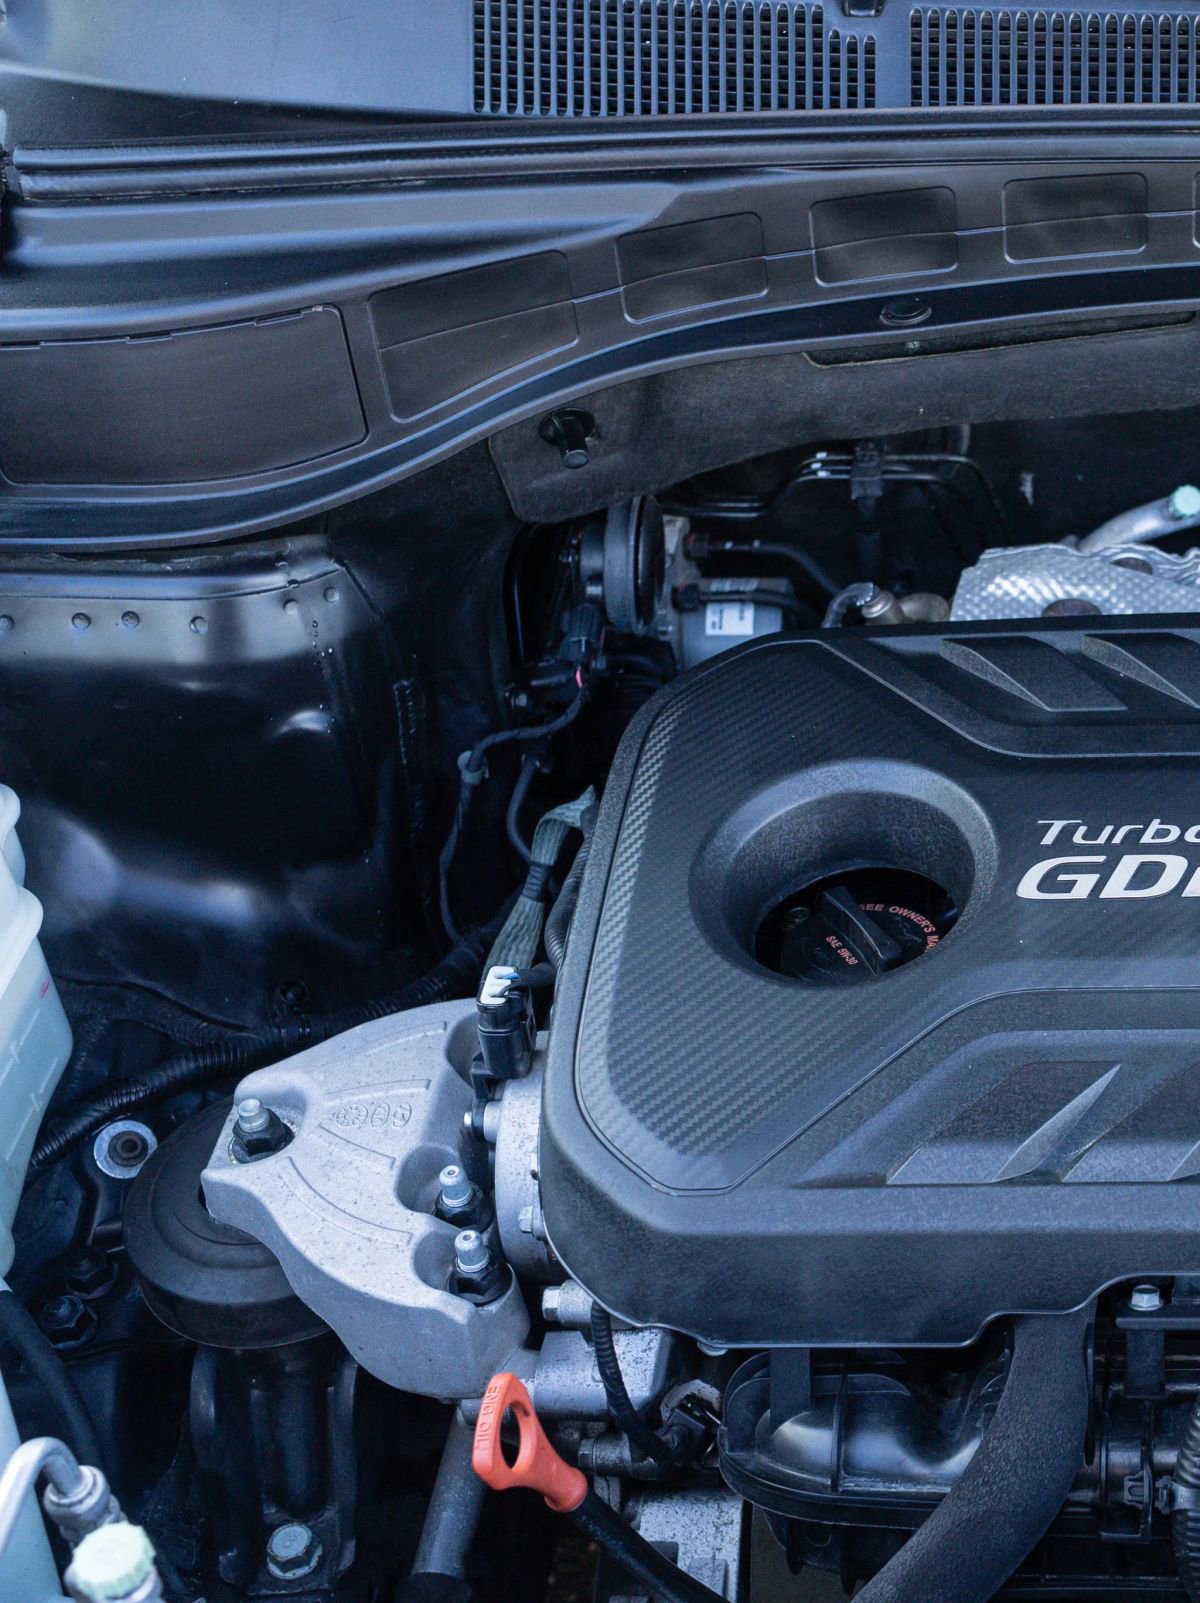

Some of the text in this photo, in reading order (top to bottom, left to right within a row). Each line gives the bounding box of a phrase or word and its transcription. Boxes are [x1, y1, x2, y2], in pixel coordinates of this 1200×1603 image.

[888, 905, 936, 933] OWNER'S
[826, 935, 843, 950] SAE
[475, 1384, 501, 1449] ENG OIL
